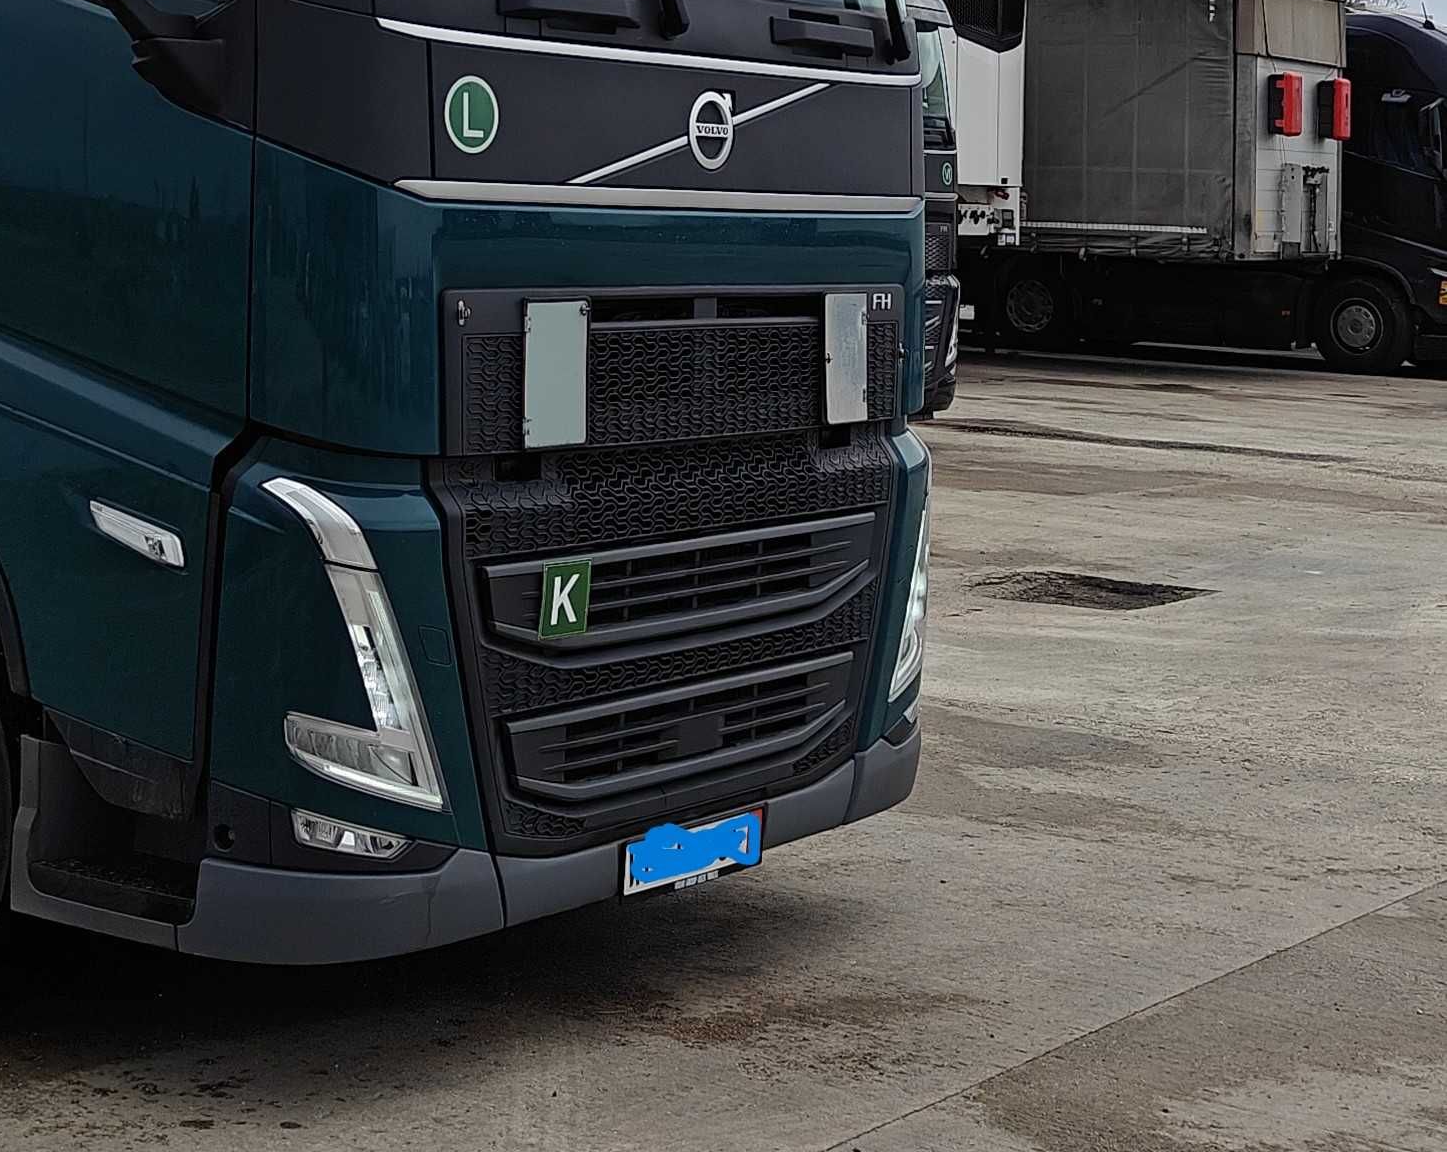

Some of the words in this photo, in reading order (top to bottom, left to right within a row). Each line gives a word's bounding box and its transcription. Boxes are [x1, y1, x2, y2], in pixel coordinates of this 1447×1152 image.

[462, 90, 485, 138] L
[696, 125, 729, 136] VOLVO
[873, 293, 892, 310] FH
[550, 573, 581, 626] K
